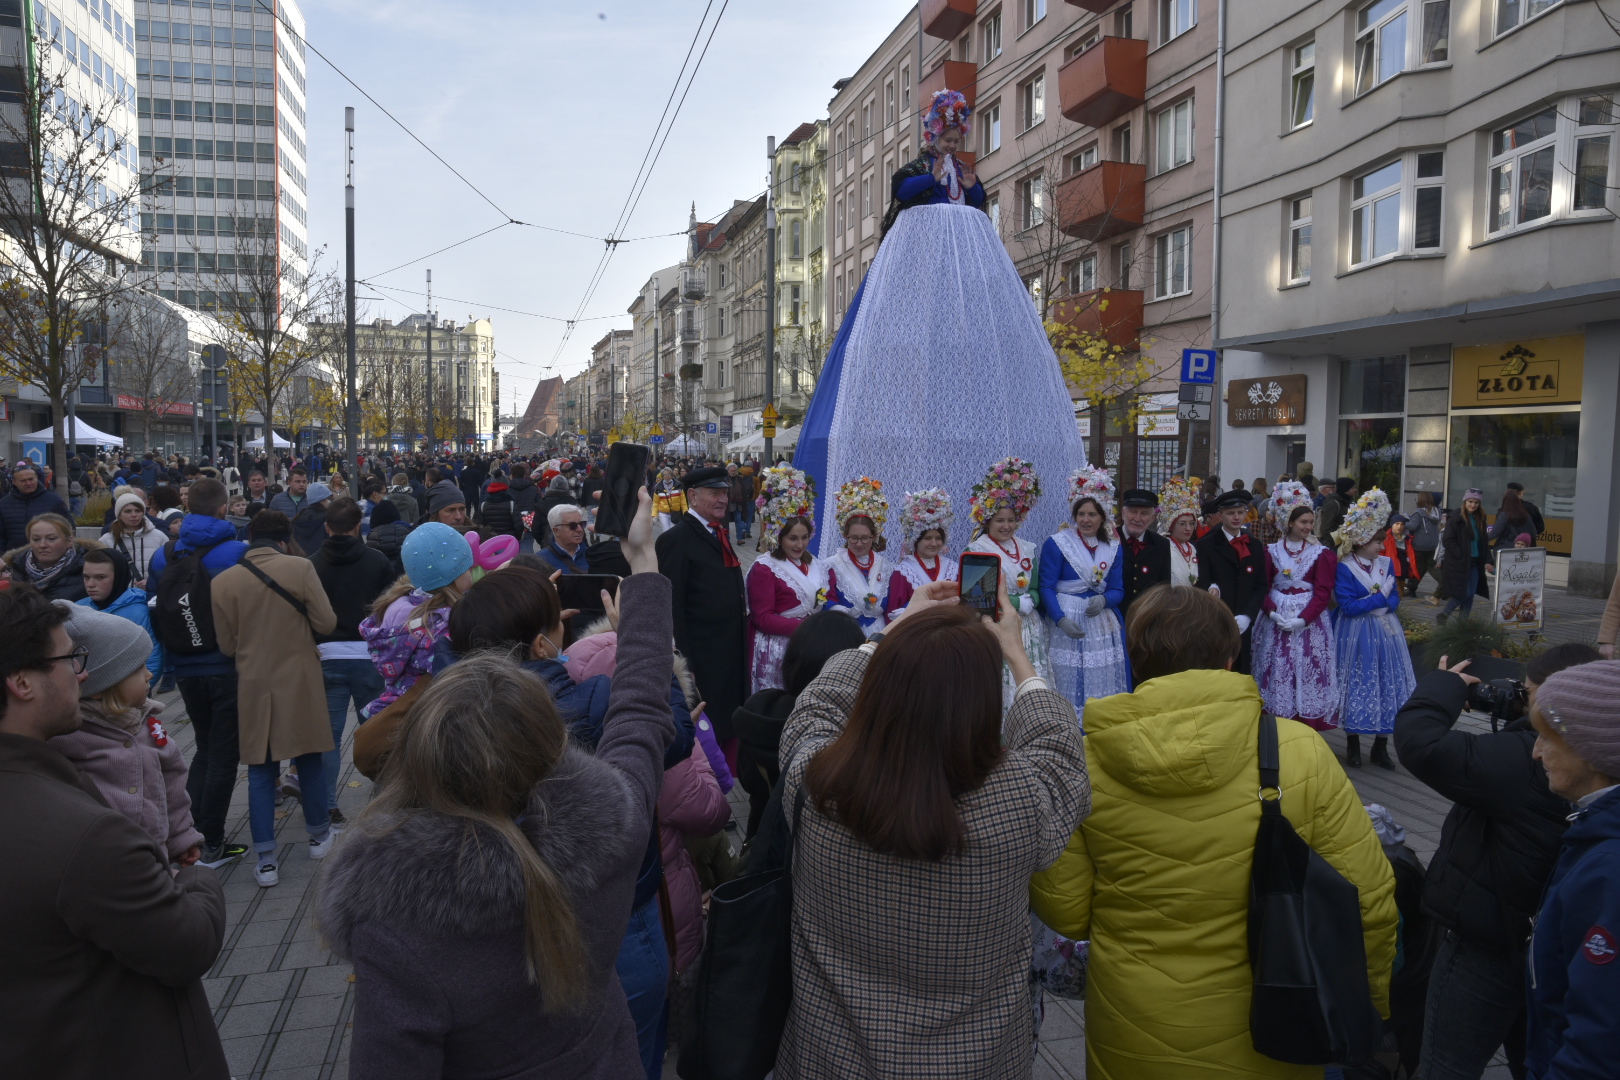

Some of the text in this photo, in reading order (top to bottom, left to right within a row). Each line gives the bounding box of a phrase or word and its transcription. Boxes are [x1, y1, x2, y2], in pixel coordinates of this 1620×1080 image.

[1188, 352, 1210, 380] P
[1478, 375, 1556, 393] ZŁOTA
[1235, 407, 1265, 420] SEKRETY
[181, 607, 203, 647] Reebok
